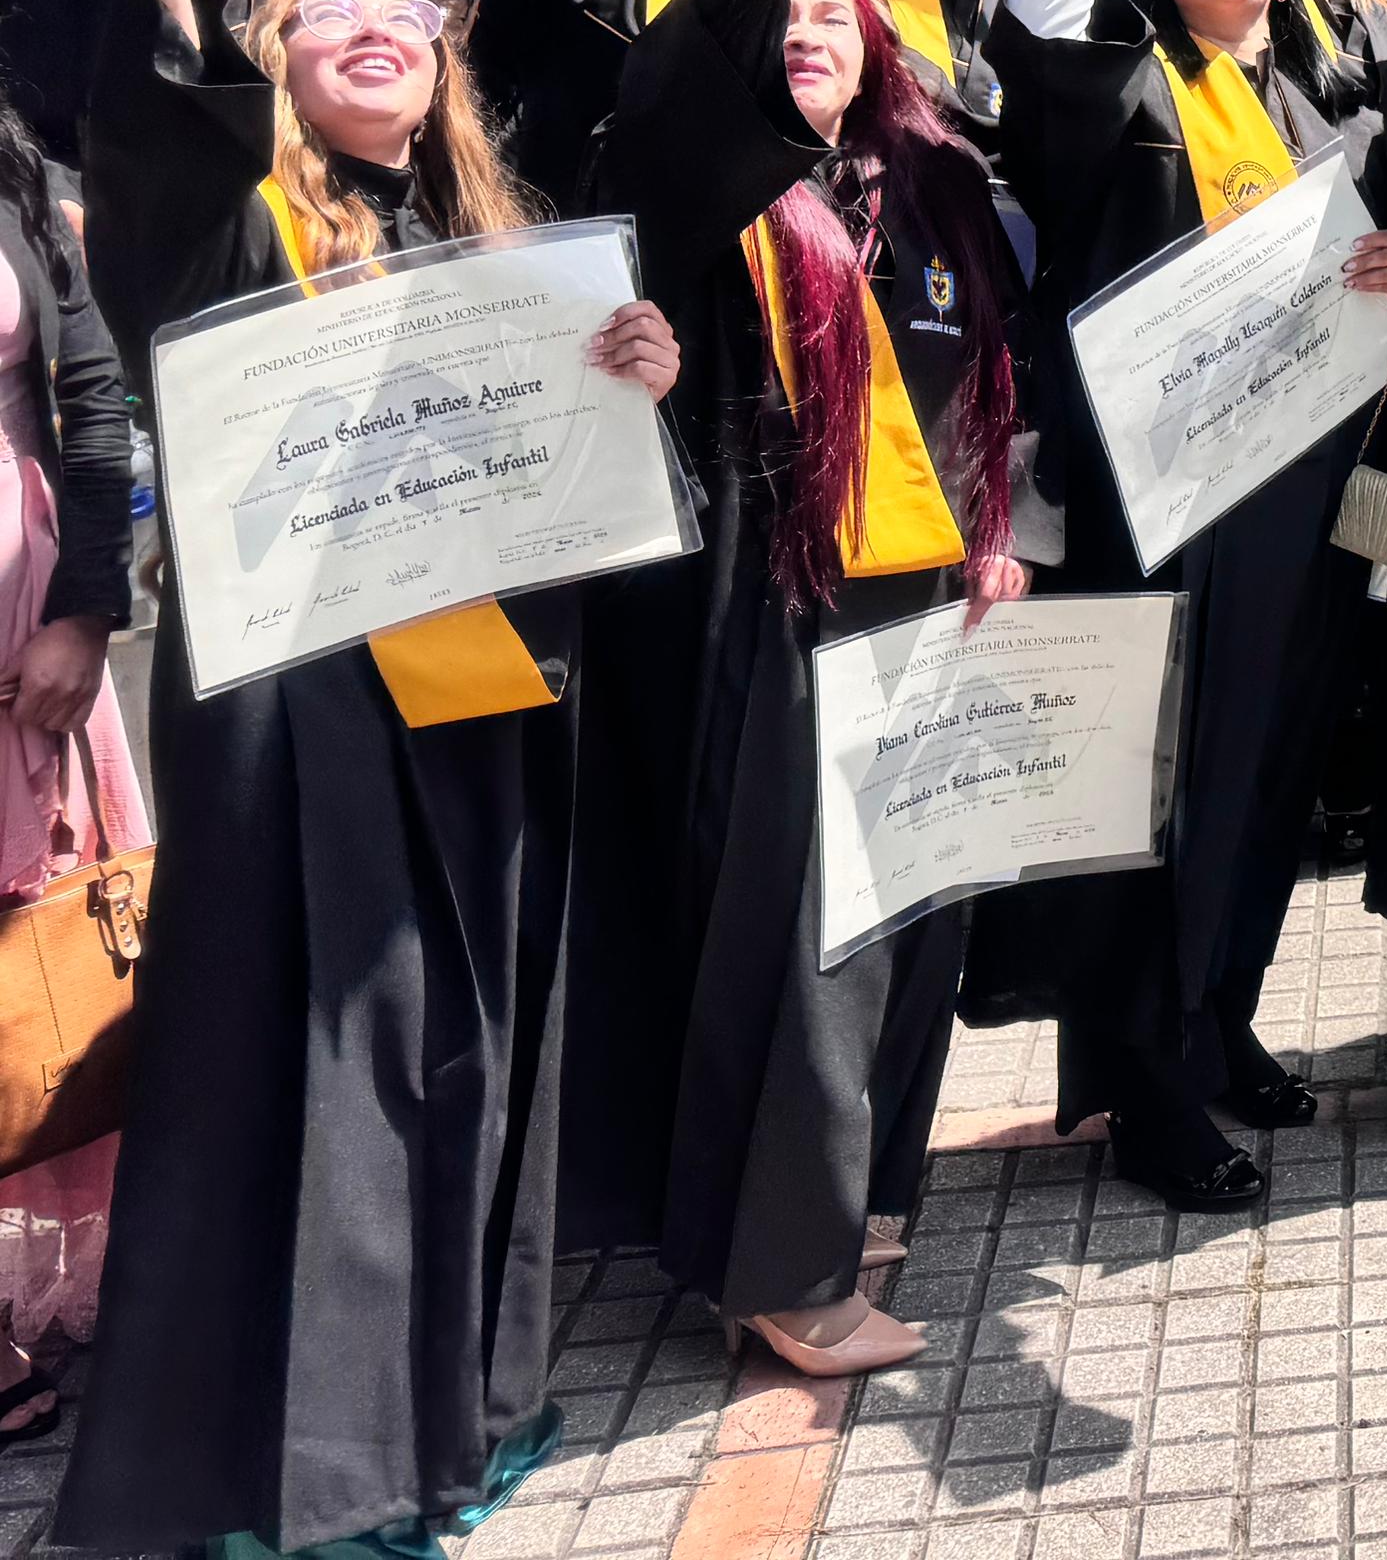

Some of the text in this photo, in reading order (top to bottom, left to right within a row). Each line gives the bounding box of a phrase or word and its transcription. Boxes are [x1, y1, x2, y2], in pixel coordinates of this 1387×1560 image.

[240, 341, 330, 381] FUNDACIÓN
[331, 312, 442, 353] UNIVERSITARIA
[444, 285, 552, 329] MONSERRATE
[1133, 291, 1193, 341] FUNDACIÓN
[1192, 247, 1263, 304] UNIVERSITARIA
[1157, 268, 1333, 401] Elvia Magally Usaquén Calderón
[272, 426, 331, 472] Laura
[333, 403, 408, 449] Gabriela
[410, 385, 473, 424] Muñoz
[474, 369, 544, 410] Aguirre
[1182, 325, 1332, 445] Licenciada en Educación Infantil
[287, 493, 371, 537] Licenciada
[374, 492, 392, 507] en
[393, 461, 479, 504] Educación
[482, 442, 550, 480] Infantil
[929, 636, 1013, 665] UNIVERSITARIA
[1016, 624, 1101, 657] MONSERRATE
[913, 710, 960, 740] Carolina
[965, 691, 1024, 725] Gutiérrez
[1029, 684, 1077, 715] Muñoz
[884, 787, 932, 821] Licenciada
[935, 782, 947, 796] en
[951, 761, 1011, 793] Educación
[1015, 748, 1067, 780] Infantil
